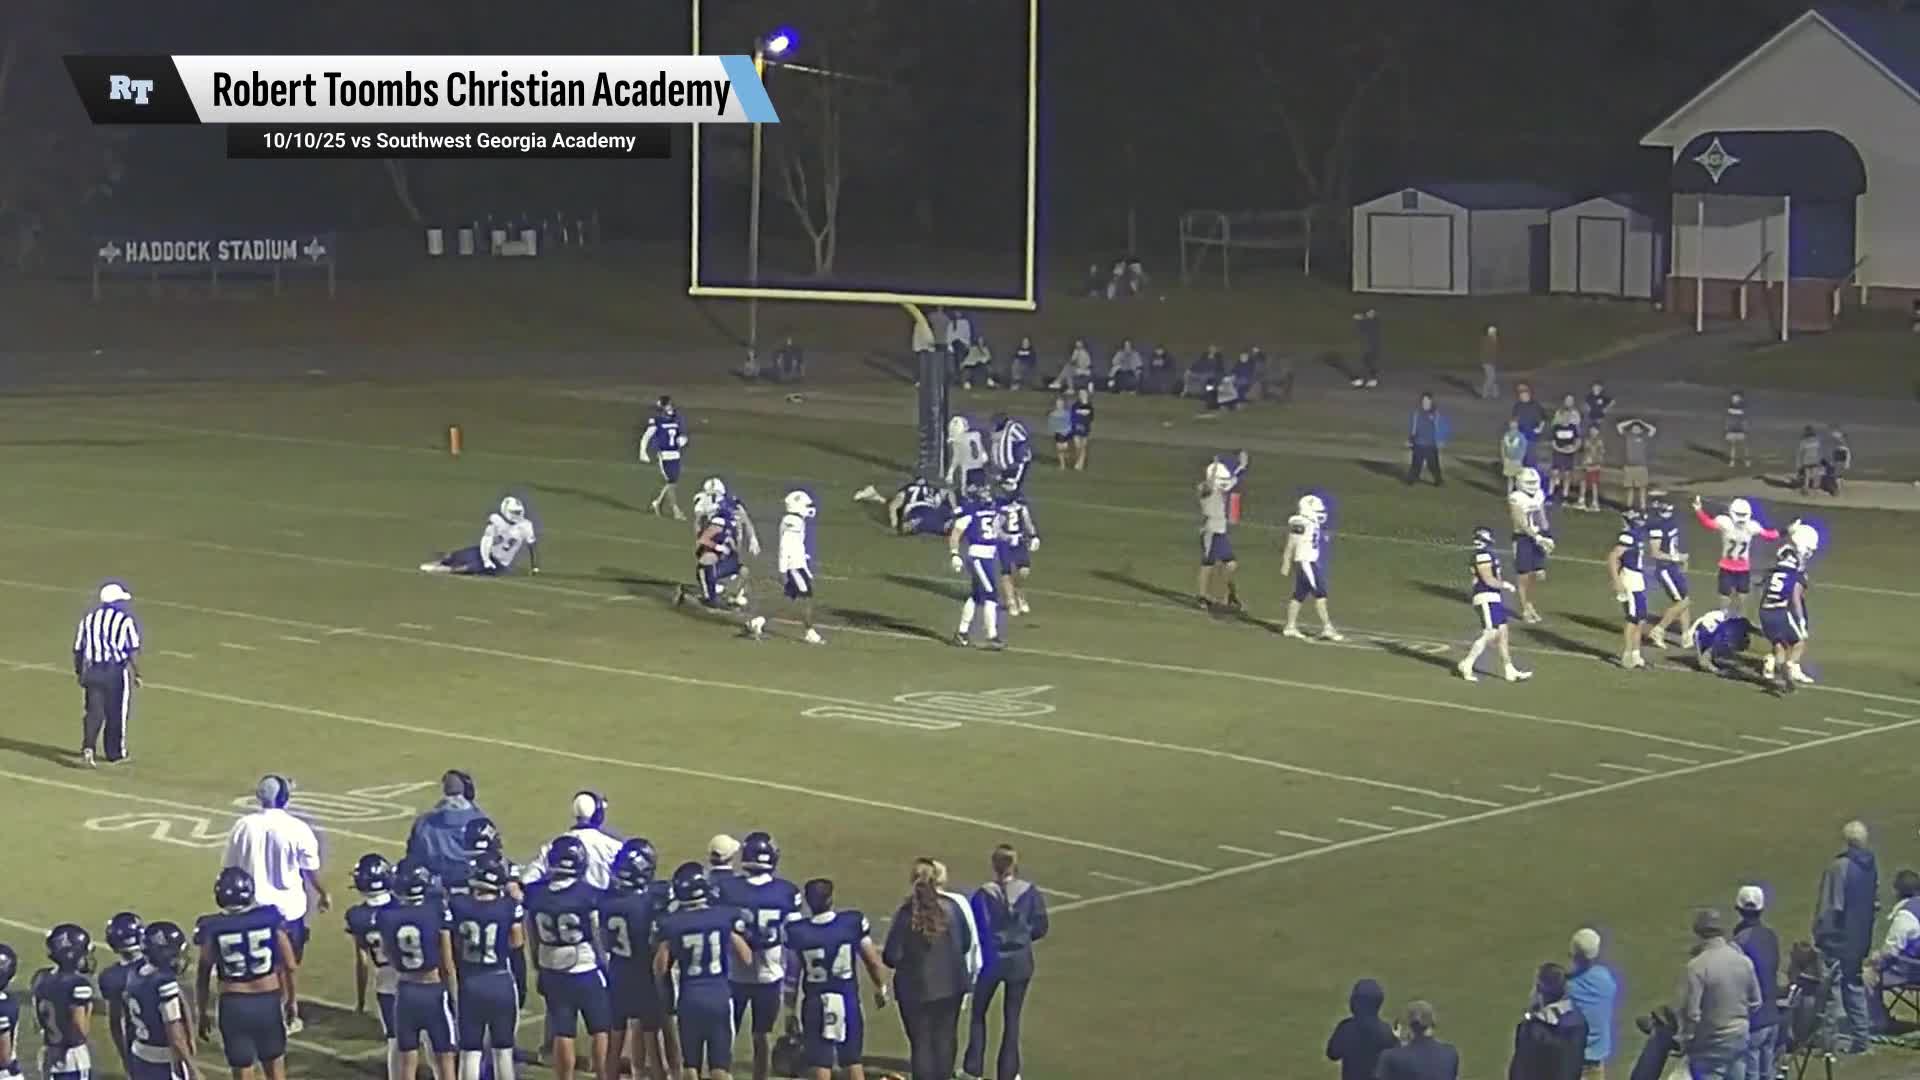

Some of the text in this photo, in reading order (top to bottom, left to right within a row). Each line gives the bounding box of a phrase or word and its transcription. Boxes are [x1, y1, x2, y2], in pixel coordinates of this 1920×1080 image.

[126, 239, 298, 262] HADDOCK STADIUM
[1769, 571, 1788, 593] 5
[218, 927, 272, 977] 55
[397, 925, 425, 970] 9
[459, 920, 498, 964] 21
[682, 930, 723, 976] 71
